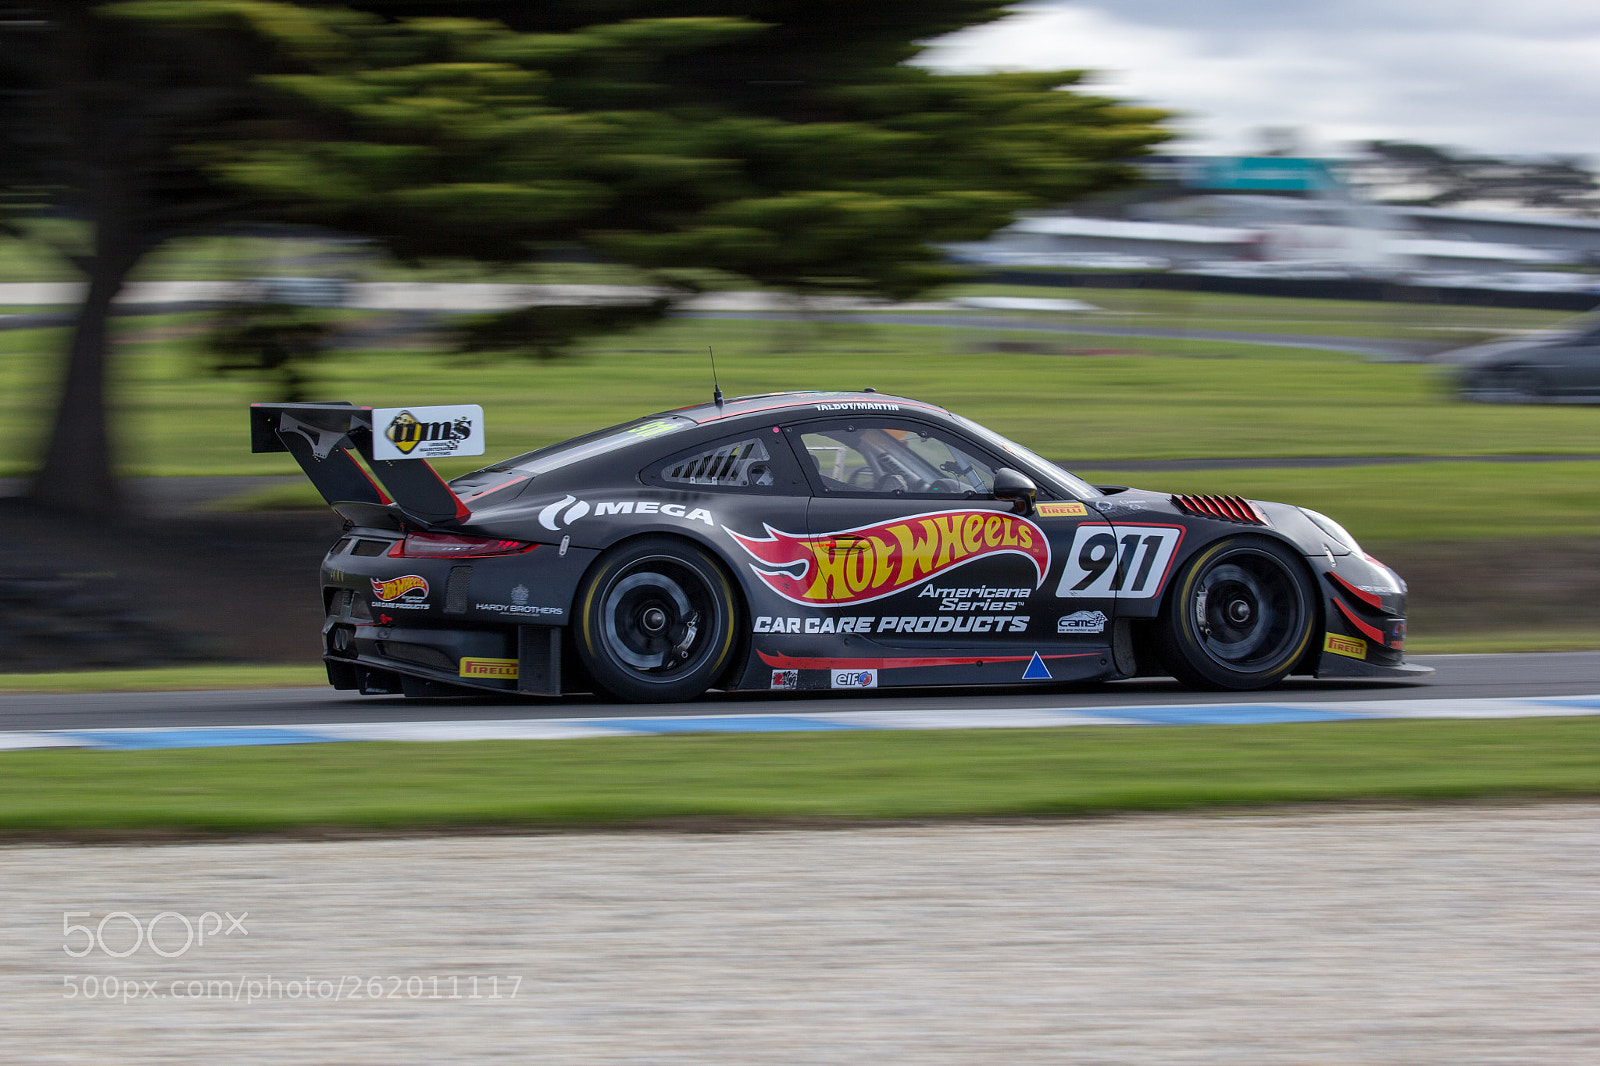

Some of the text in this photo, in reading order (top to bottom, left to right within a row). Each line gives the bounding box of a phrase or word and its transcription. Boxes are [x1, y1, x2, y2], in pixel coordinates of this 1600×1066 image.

[816, 402, 900, 411] TALBOT/MARTIN
[594, 501, 714, 526] MEGA
[1040, 505, 1082, 514] PIRELLI
[797, 535, 896, 600] HOT
[884, 514, 1033, 586] WHEELS
[1071, 533, 1164, 591] 911
[918, 583, 1031, 598] Americana
[475, 603, 509, 611] HARDY
[510, 605, 564, 615] BROTHERS
[939, 598, 1017, 611] Series
[753, 616, 1030, 633] CAR CARE PRODUCTS
[1059, 619, 1096, 627] cams
[1328, 637, 1364, 655] PIRELLI
[465, 661, 518, 675] PIRELLI
[836, 672, 859, 686] elf
